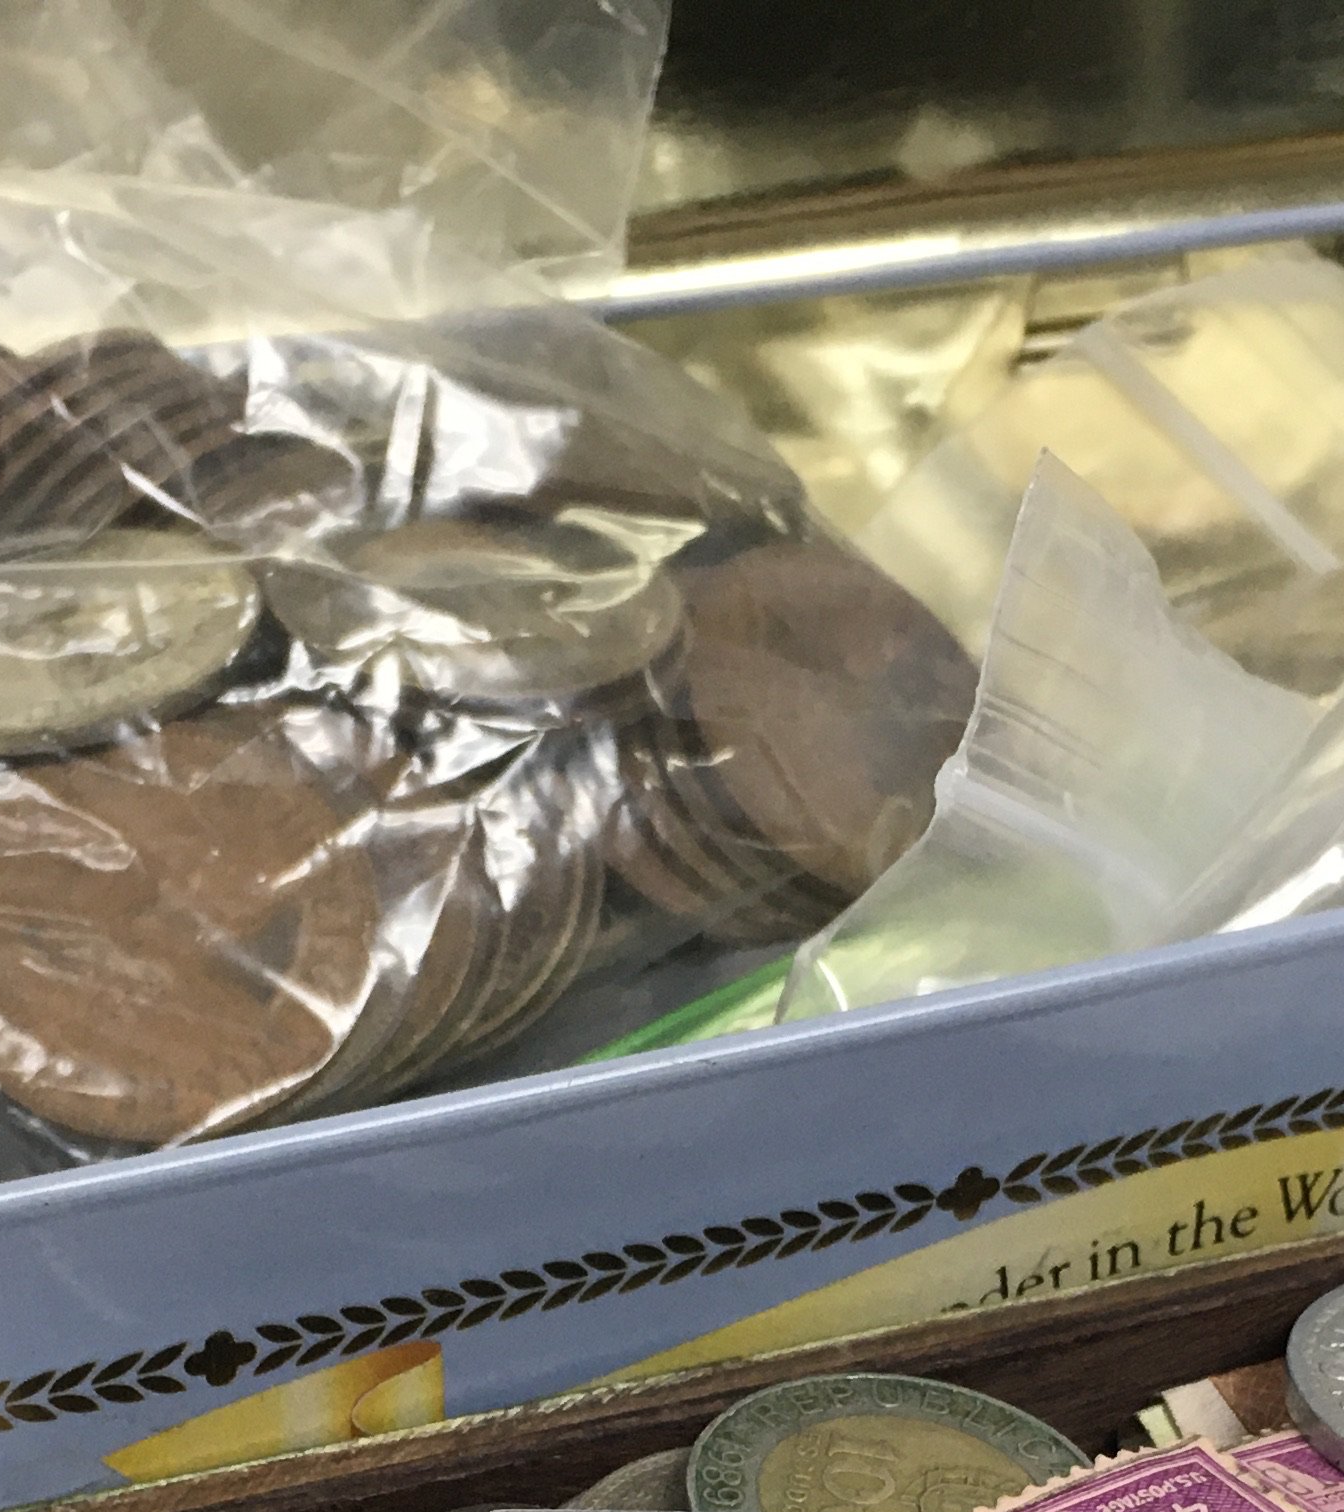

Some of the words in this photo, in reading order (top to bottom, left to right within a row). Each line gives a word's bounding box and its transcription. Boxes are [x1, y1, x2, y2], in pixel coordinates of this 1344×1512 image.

[940, 1265, 1071, 1313] der
[1089, 1239, 1141, 1281] in
[1167, 1201, 1258, 1257] the
[702, 1434, 752, 1507] 1989
